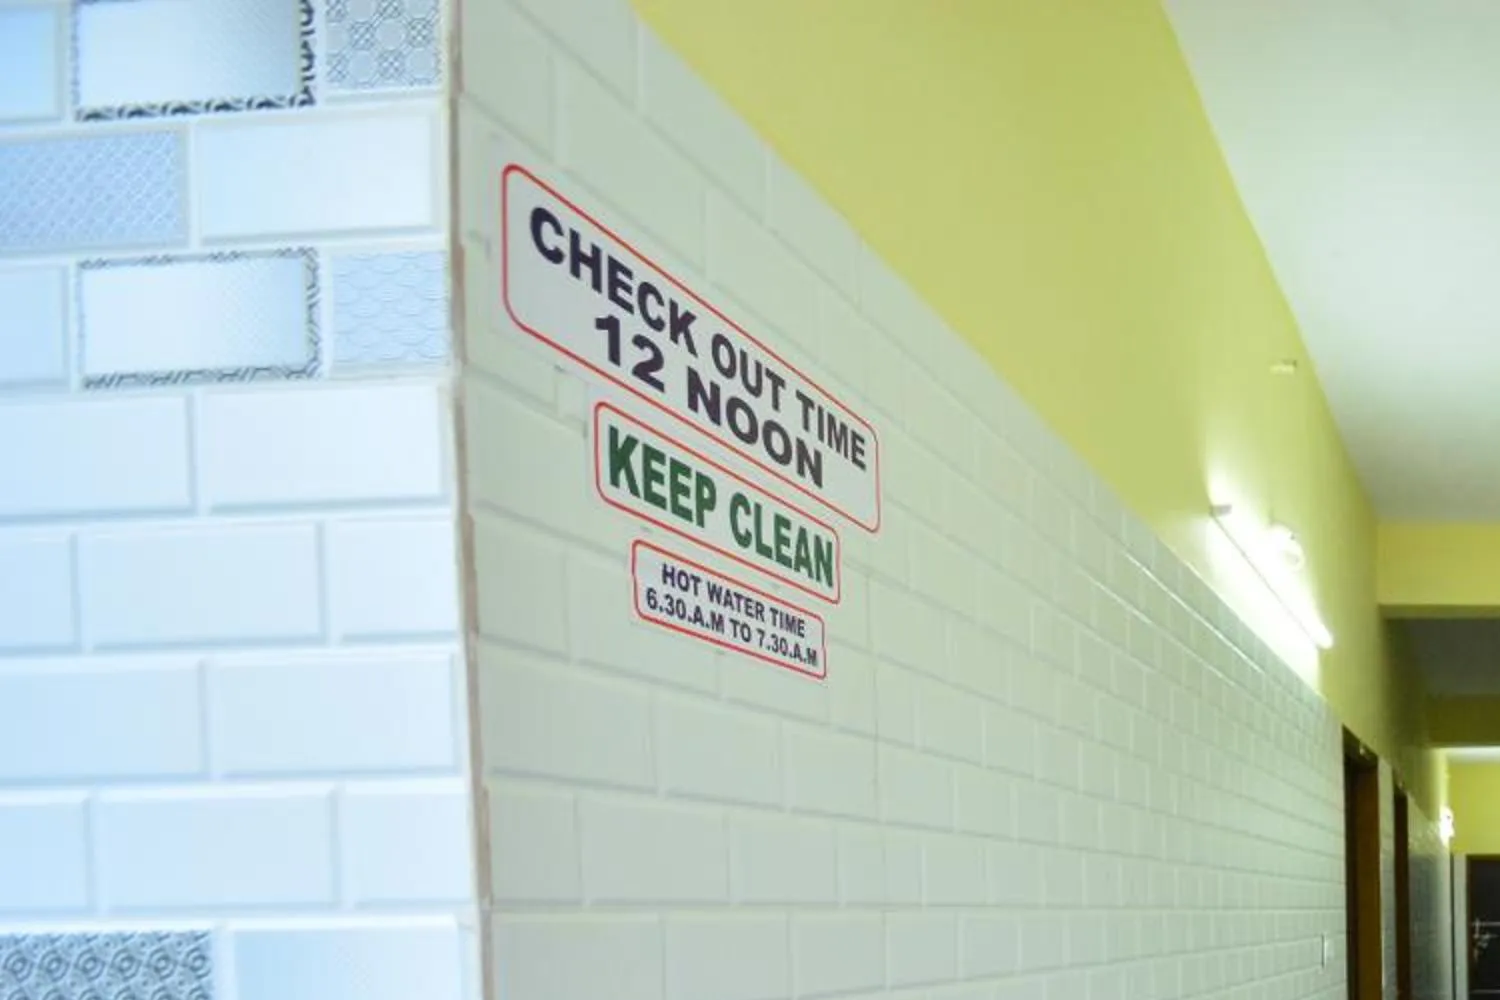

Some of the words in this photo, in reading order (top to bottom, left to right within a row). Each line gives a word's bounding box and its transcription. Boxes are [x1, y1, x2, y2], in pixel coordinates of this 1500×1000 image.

[530, 206, 698, 358] CHECK
[710, 333, 786, 412] OUT
[796, 389, 867, 471] TIME
[595, 315, 666, 394] 12
[686, 365, 823, 489] NOON
[608, 423, 717, 529] KEEP
[729, 493, 834, 589] CLEAN
[646, 587, 725, 634] 6.30.A.M
[729, 619, 752, 643] TO
[662, 563, 702, 596] HOT
[707, 582, 765, 623] WATER
[769, 608, 805, 638] TIME
